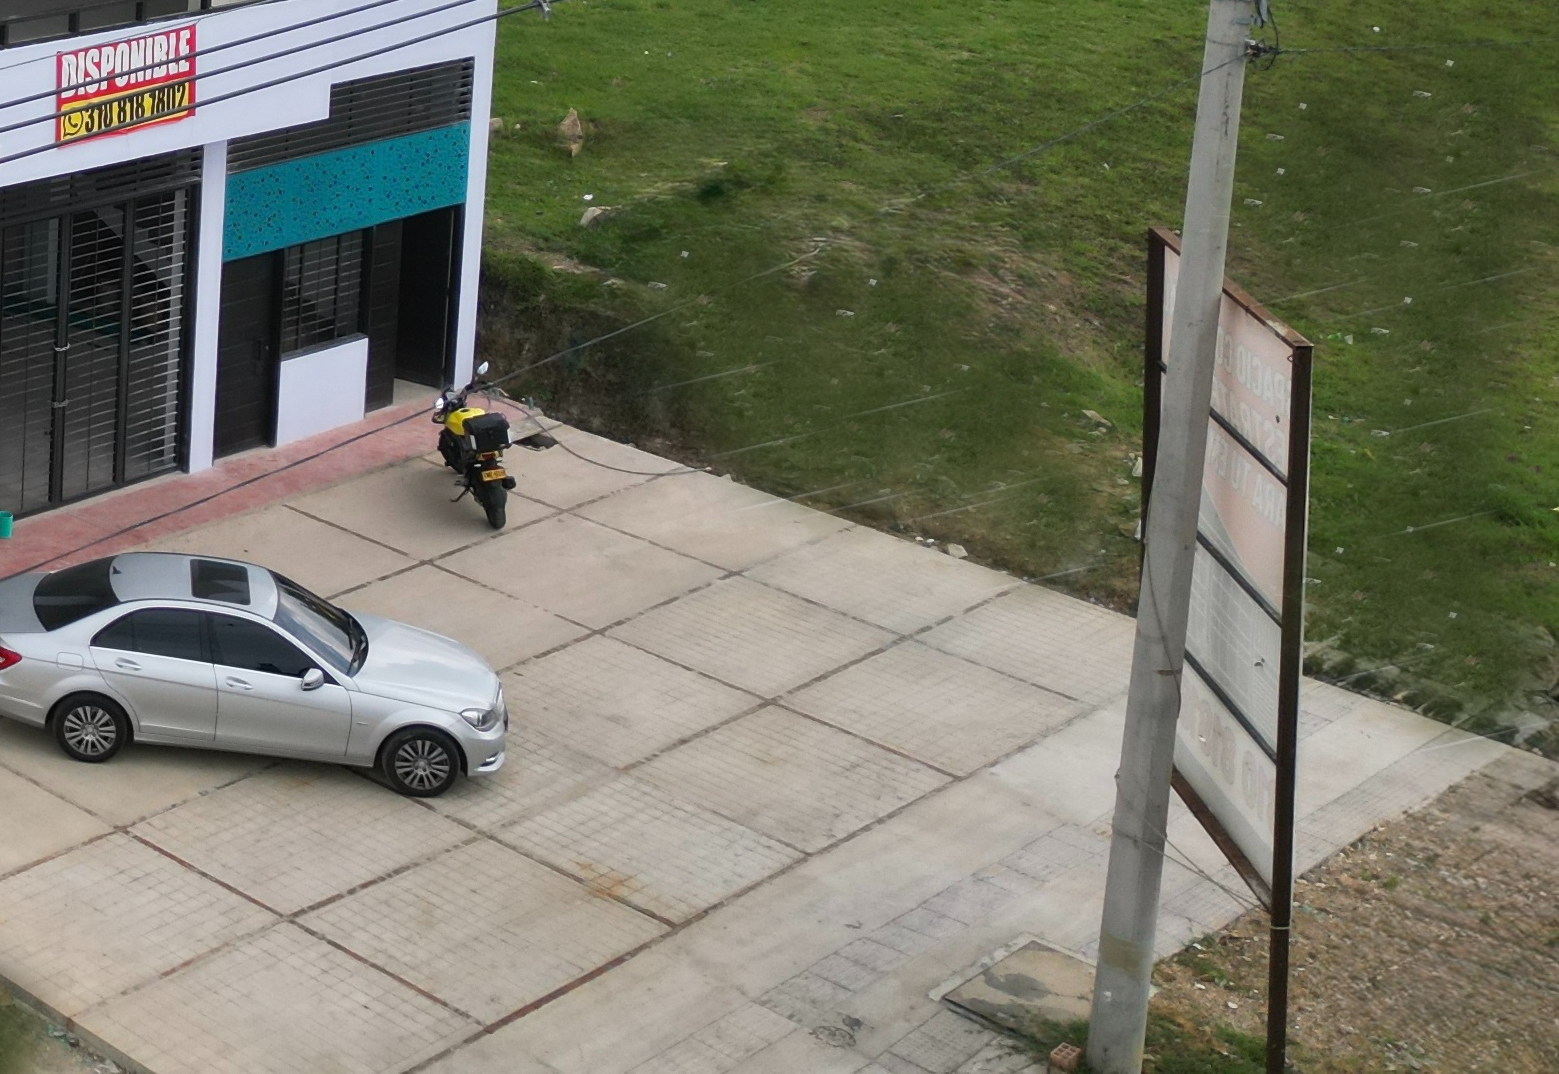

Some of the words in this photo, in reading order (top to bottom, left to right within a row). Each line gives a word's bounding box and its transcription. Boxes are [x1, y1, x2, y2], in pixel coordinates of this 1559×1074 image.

[61, 29, 191, 99] DISPONIBLE
[84, 101, 114, 133] 310
[117, 93, 146, 125] 818
